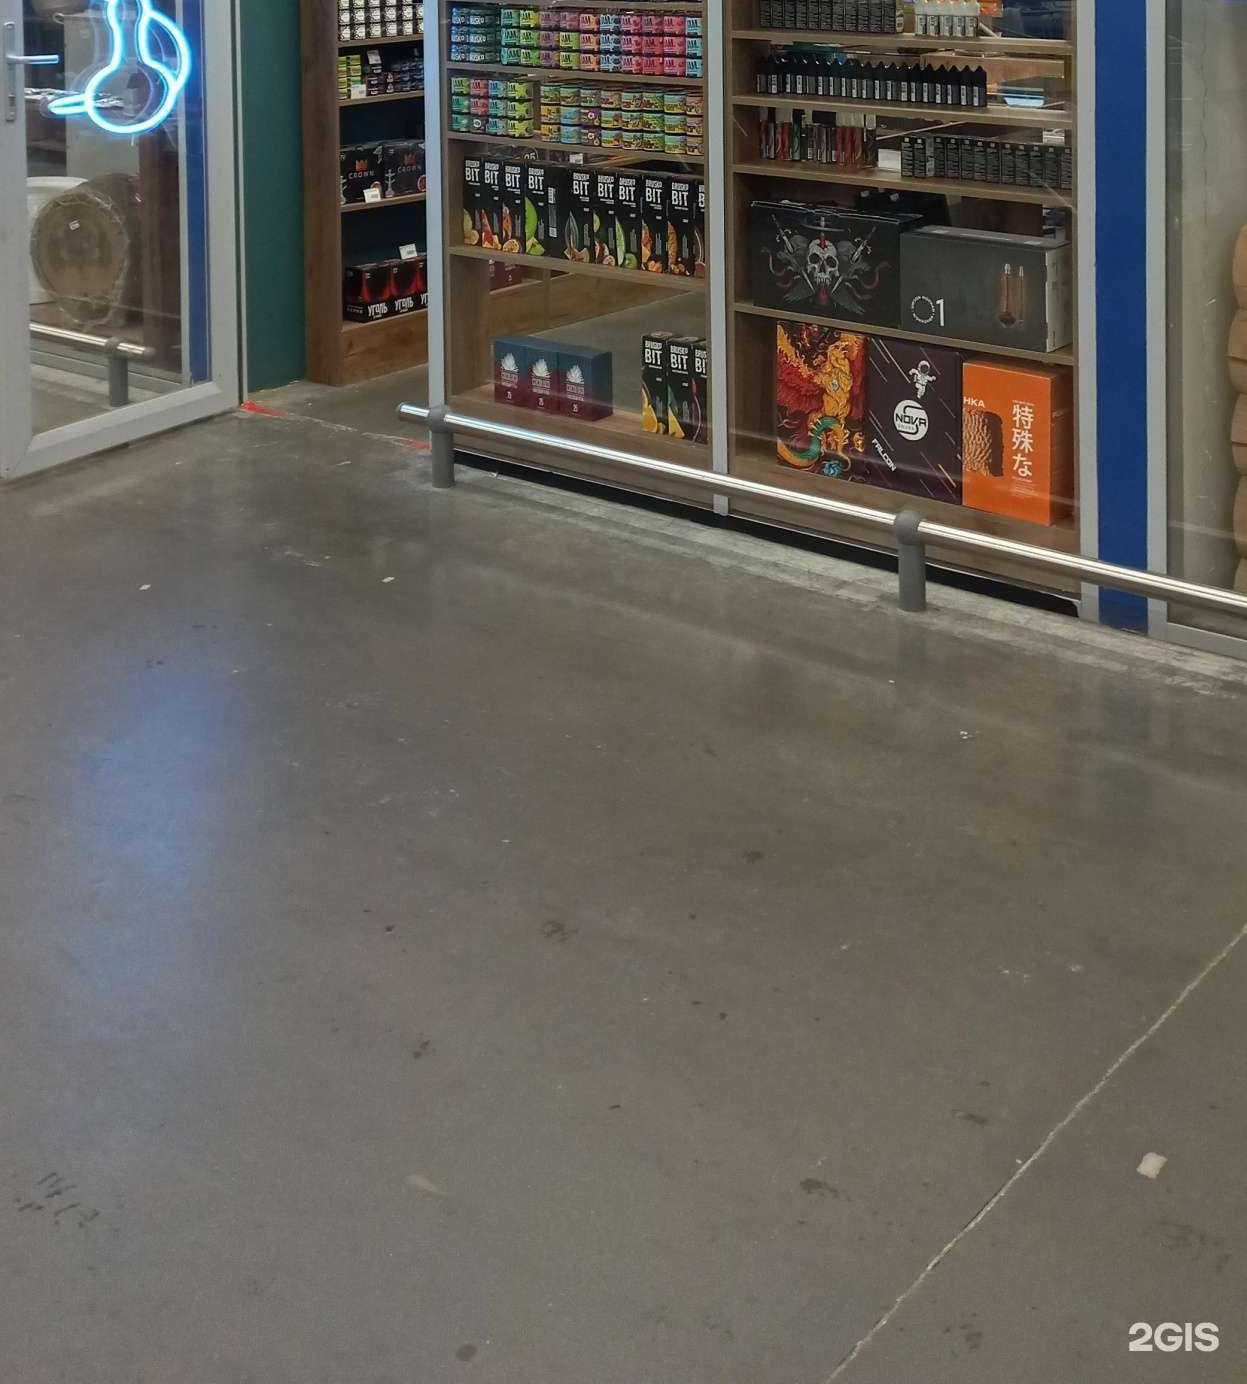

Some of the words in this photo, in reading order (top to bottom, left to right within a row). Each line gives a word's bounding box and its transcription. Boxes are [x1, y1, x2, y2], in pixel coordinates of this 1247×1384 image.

[465, 168, 480, 182] BIT
[485, 170, 499, 185] BIT
[505, 174, 521, 188] BIT
[528, 176, 544, 190] BIT
[573, 181, 589, 196] BIT
[598, 183, 614, 198] BIT
[619, 186, 635, 201] BIT
[646, 188, 662, 203] BIT
[672, 191, 688, 206] BIT
[645, 349, 662, 365] BIT
[671, 354, 688, 370] BIT
[695, 358, 707, 374] BI
[895, 412, 926, 428] NOVA
[1012, 404, 1034, 478] 特殊な
[872, 438, 897, 472] FALCON
